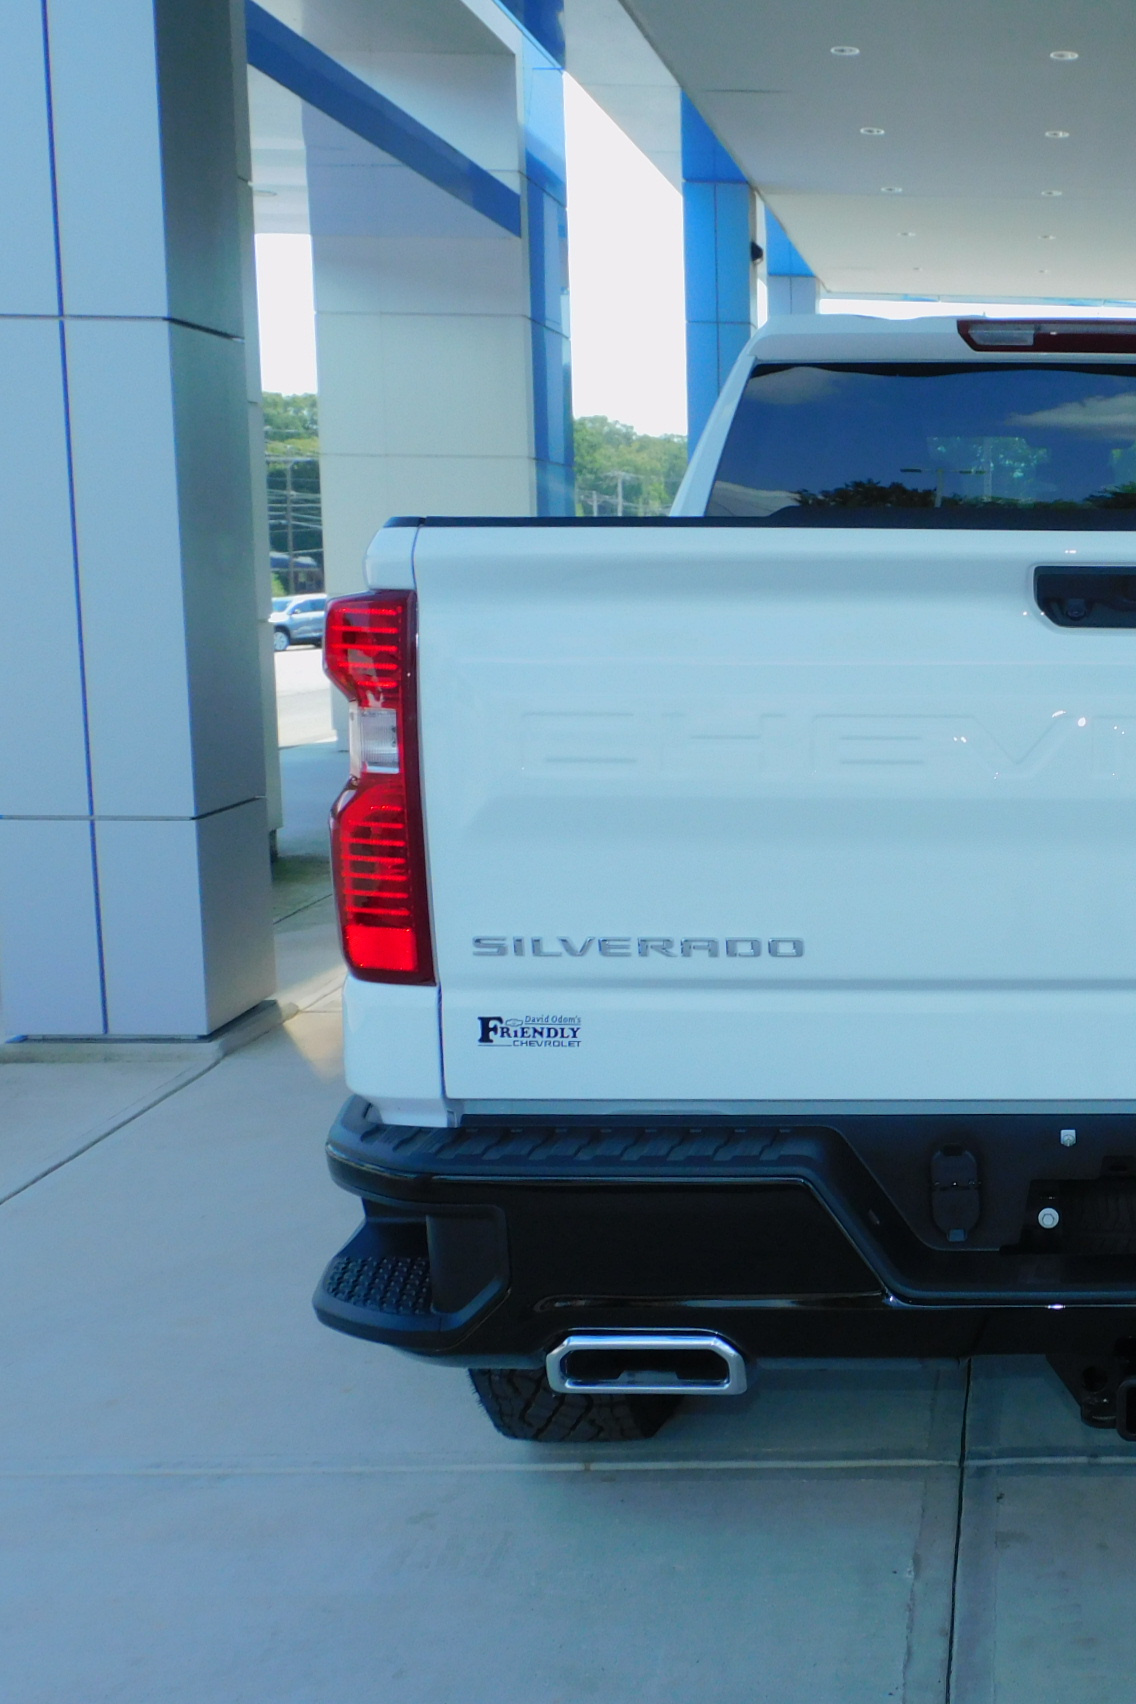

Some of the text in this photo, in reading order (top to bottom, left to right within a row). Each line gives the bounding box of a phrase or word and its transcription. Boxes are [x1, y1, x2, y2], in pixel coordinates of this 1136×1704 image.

[472, 935, 805, 958] SILVERADO
[525, 1015, 581, 1023] David Odom's
